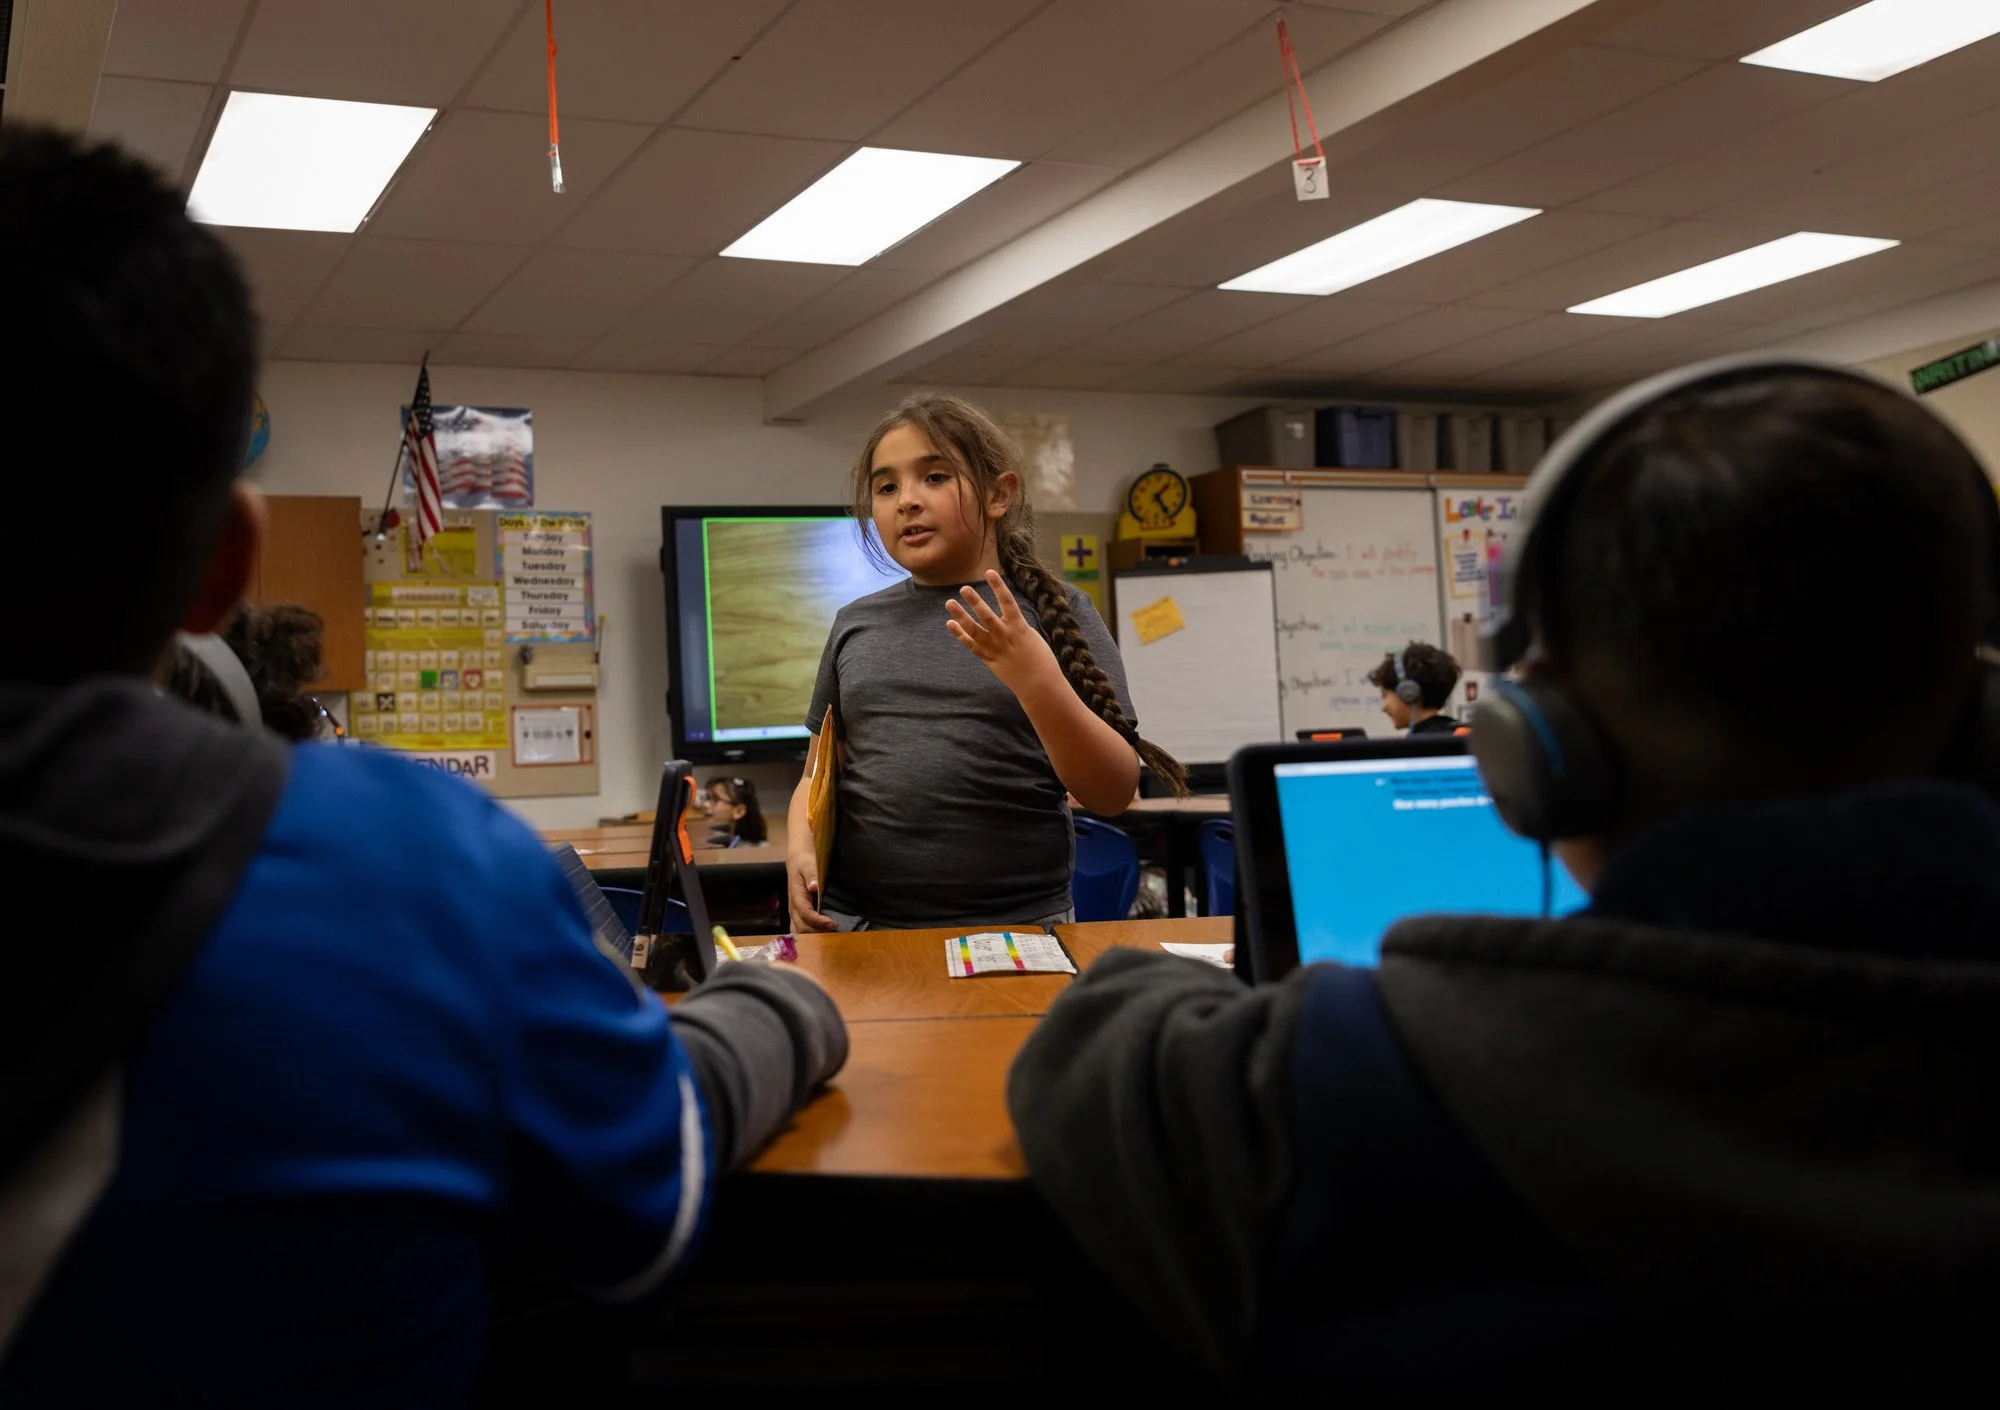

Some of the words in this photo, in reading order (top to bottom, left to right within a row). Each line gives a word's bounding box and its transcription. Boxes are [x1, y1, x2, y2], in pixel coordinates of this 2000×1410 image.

[1304, 167, 1318, 194] 3
[499, 517, 524, 528] Days
[522, 546, 566, 556] Monday
[522, 561, 567, 572] Tuesday
[513, 576, 576, 587] Wednesday
[521, 590, 570, 601] Thursday
[528, 605, 562, 616] Friday
[522, 620, 570, 630] Satuday
[402, 754, 490, 778] ENDAR
